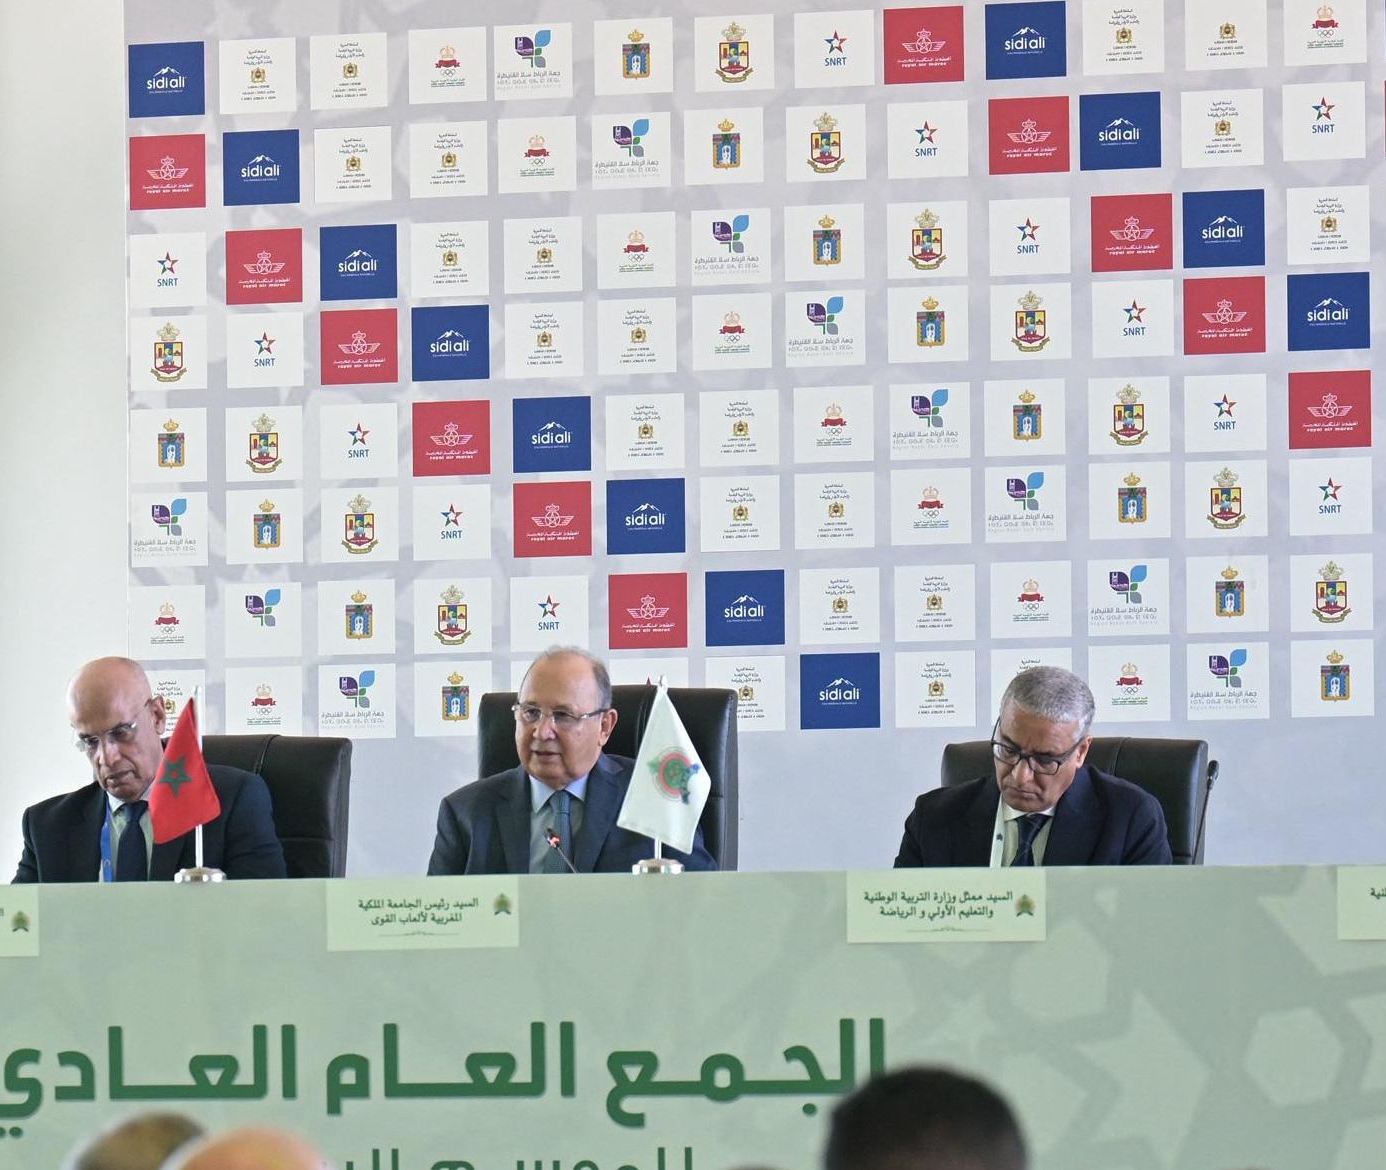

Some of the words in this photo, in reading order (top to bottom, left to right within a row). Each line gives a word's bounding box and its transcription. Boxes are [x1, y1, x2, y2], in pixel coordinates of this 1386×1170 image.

[1004, 37, 1028, 51] sidi
[1028, 36, 1045, 50] ali
[824, 56, 847, 67] SNRT
[146, 76, 169, 90] sidi
[169, 75, 185, 89] ali
[1098, 128, 1122, 142] sidi
[1122, 127, 1140, 141] ali
[1312, 124, 1335, 134] SNRT
[915, 147, 938, 157] SNRT
[241, 164, 263, 178] sidi
[263, 163, 280, 177] ali
[1202, 225, 1225, 239] sidi
[1226, 225, 1243, 238] ali
[1017, 244, 1040, 254] SNRT
[338, 259, 360, 273] sidi
[360, 258, 377, 272] ali
[157, 277, 178, 287] SNRT
[1307, 308, 1330, 322] sidi
[1331, 307, 1349, 321] ali
[1123, 326, 1146, 337] SNRT
[430, 339, 452, 353] sidi
[453, 339, 469, 352] ali
[254, 358, 275, 367] SNRT
[1213, 420, 1237, 431] SNRT
[531, 431, 554, 445] sidi
[554, 430, 571, 444] ali
[348, 449, 369, 459] SNRT
[1318, 504, 1342, 514] SNRT
[625, 513, 648, 526] sidi
[648, 512, 665, 526] ali
[440, 530, 463, 540] SNRT
[724, 605, 747, 618] sidi
[747, 604, 764, 618] ali
[538, 621, 560, 631] SNRT
[819, 687, 842, 701] sidi
[843, 687, 860, 700] ali
[864, 891, 897, 904] الوطنية
[900, 891, 930, 904] التربية
[933, 891, 957, 904] وزارة
[959, 891, 983, 903] ممثل
[986, 891, 1013, 903] السيد
[358, 899, 384, 911] الملكية
[388, 899, 421, 911] الجامعة
[424, 898, 450, 910] رئيس
[453, 898, 479, 910] السيد
[880, 906, 916, 918] الرياضة
[958, 905, 994, 919] والتعليم
[431, 912, 463, 925] المغربية
[326, 1021, 576, 1116] العام
[606, 1018, 885, 1129] الجمع
